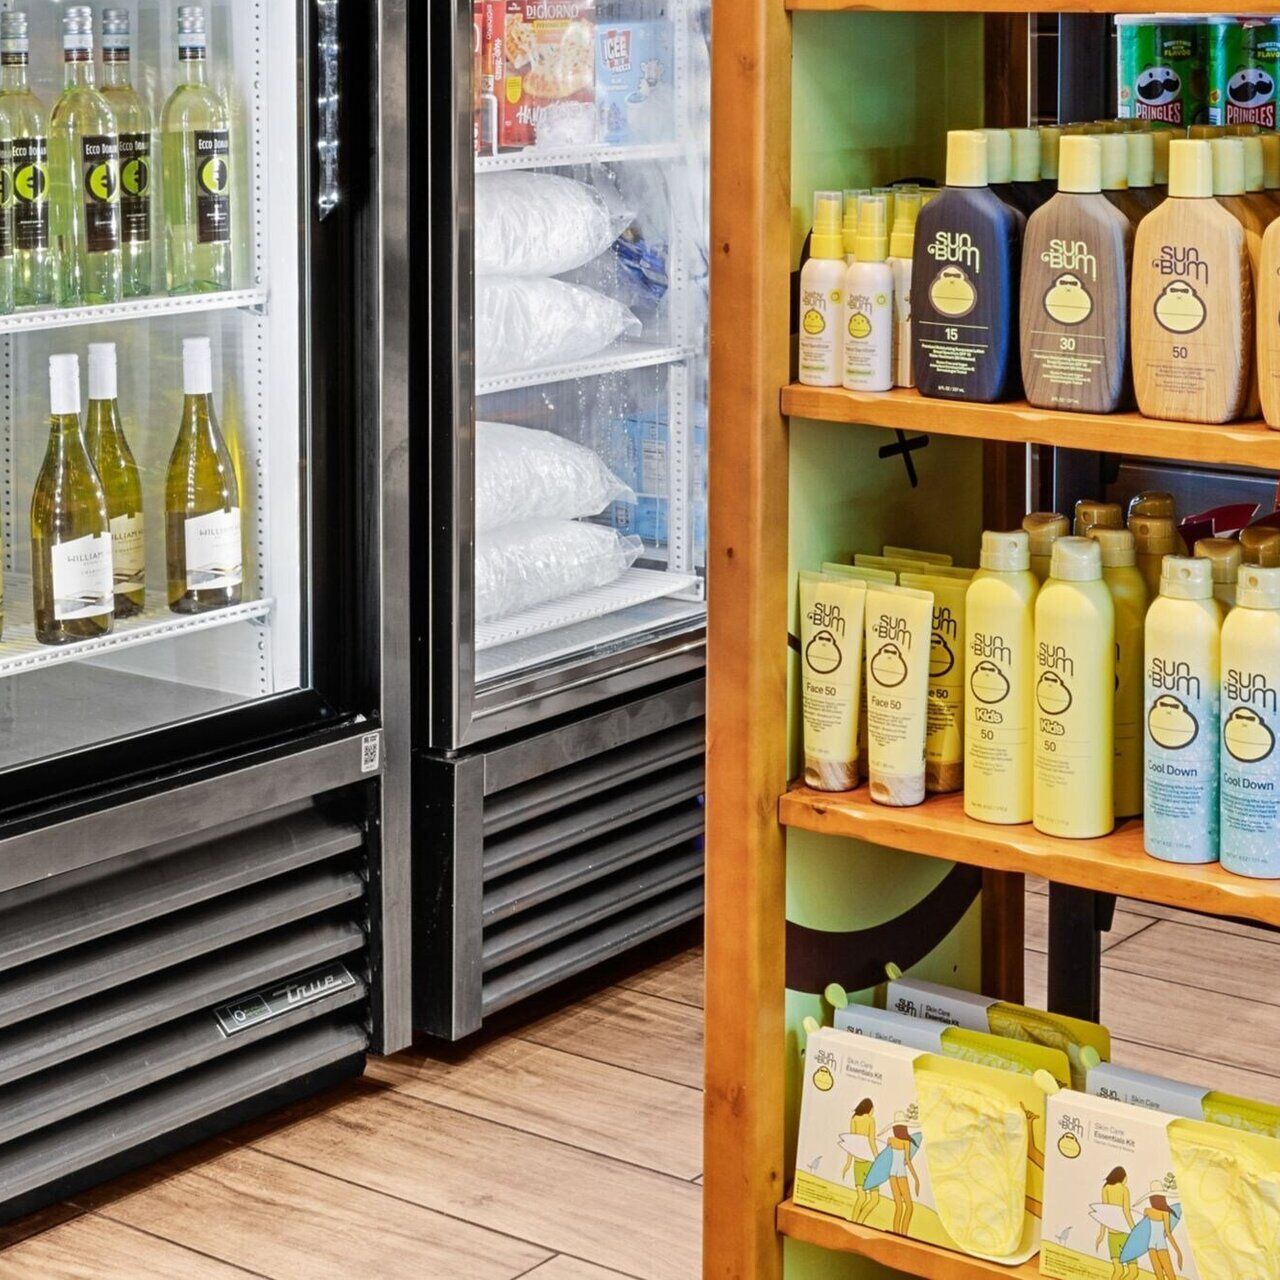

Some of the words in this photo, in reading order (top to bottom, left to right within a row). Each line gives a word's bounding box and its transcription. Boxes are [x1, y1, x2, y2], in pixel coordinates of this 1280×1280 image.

[1136, 102, 1181, 124] PRINGLES
[1227, 102, 1274, 126] PRINGLES
[945, 328, 958, 341] 15
[1060, 337, 1076, 351] 30
[1172, 346, 1188, 360] 50
[806, 684, 824, 696] Face
[825, 686, 837, 697] 50
[871, 696, 889, 708] Face
[889, 700, 902, 711] 50
[974, 708, 1003, 724] Kids
[1039, 718, 1066, 736] Kids
[981, 730, 994, 741] 50
[1044, 740, 1057, 752] 50
[1169, 763, 1199, 777] Down
[1224, 771, 1243, 787] Cool
[1243, 775, 1274, 791] Down
